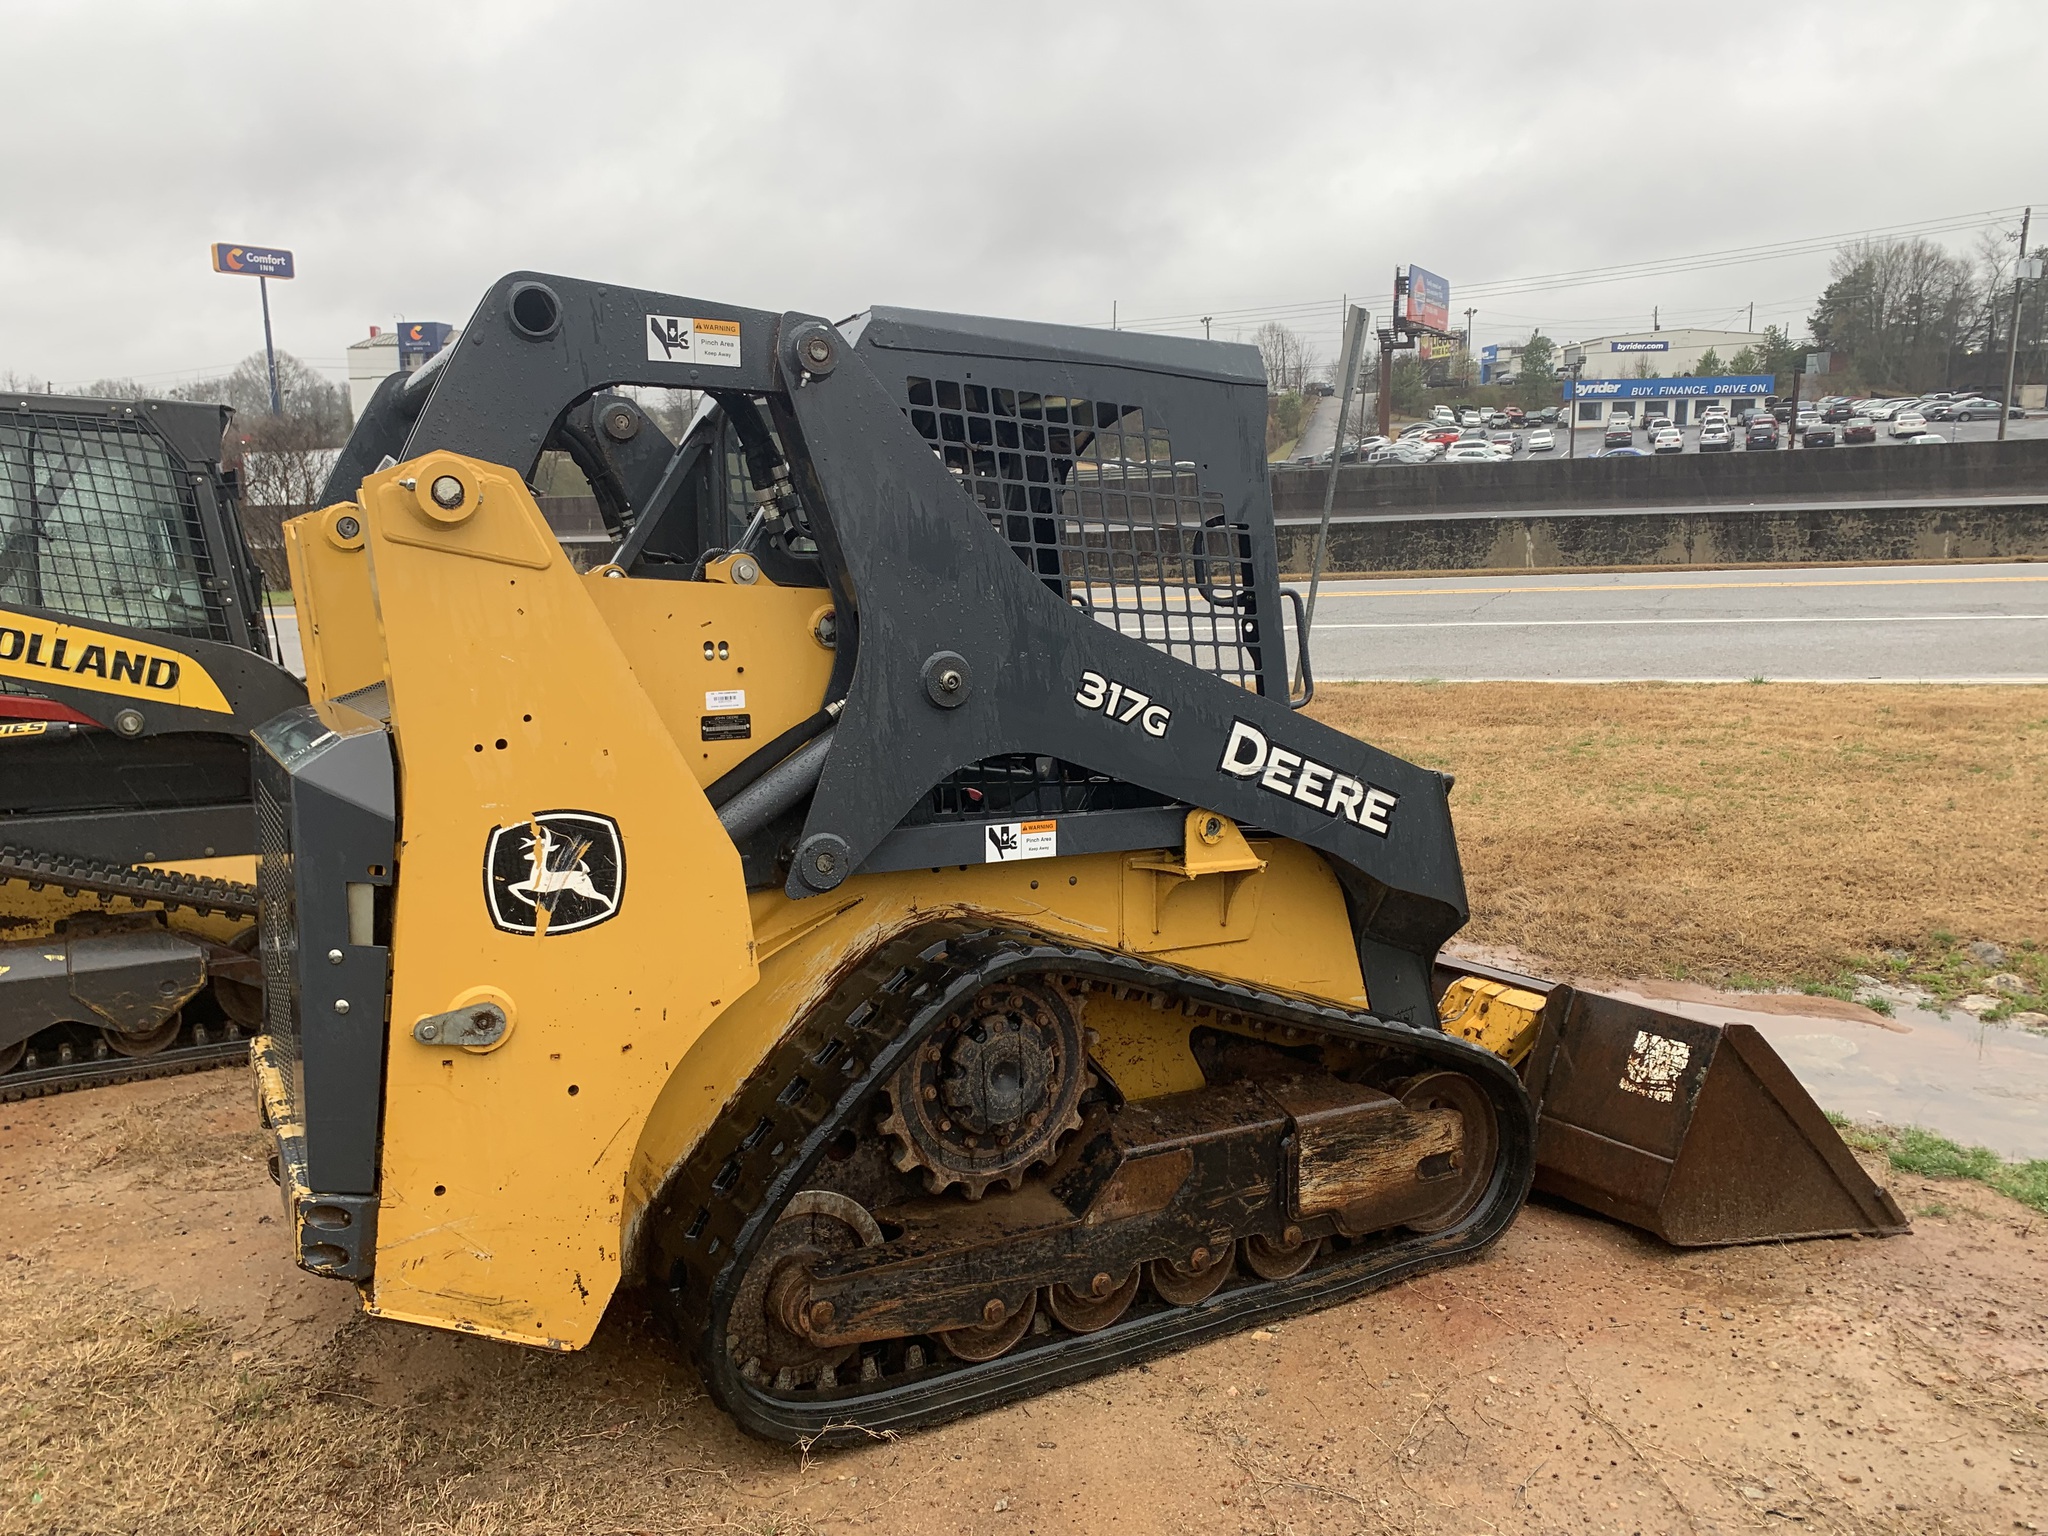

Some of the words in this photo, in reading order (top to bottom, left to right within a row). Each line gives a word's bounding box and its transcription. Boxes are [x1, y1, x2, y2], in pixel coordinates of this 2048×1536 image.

[246, 252, 286, 266] Comfort
[259, 264, 275, 273] INN
[703, 324, 736, 332] WARNING
[1617, 343, 1664, 351] byrider.com
[1575, 381, 1621, 397] byrider
[1631, 387, 1654, 396] BUY.
[1659, 386, 1708, 395] FINANCE.
[1714, 384, 1746, 393] DRIVE
[1749, 384, 1768, 393] ON.
[1075, 670, 1171, 737] 317G
[1220, 720, 1397, 834] DEERE
